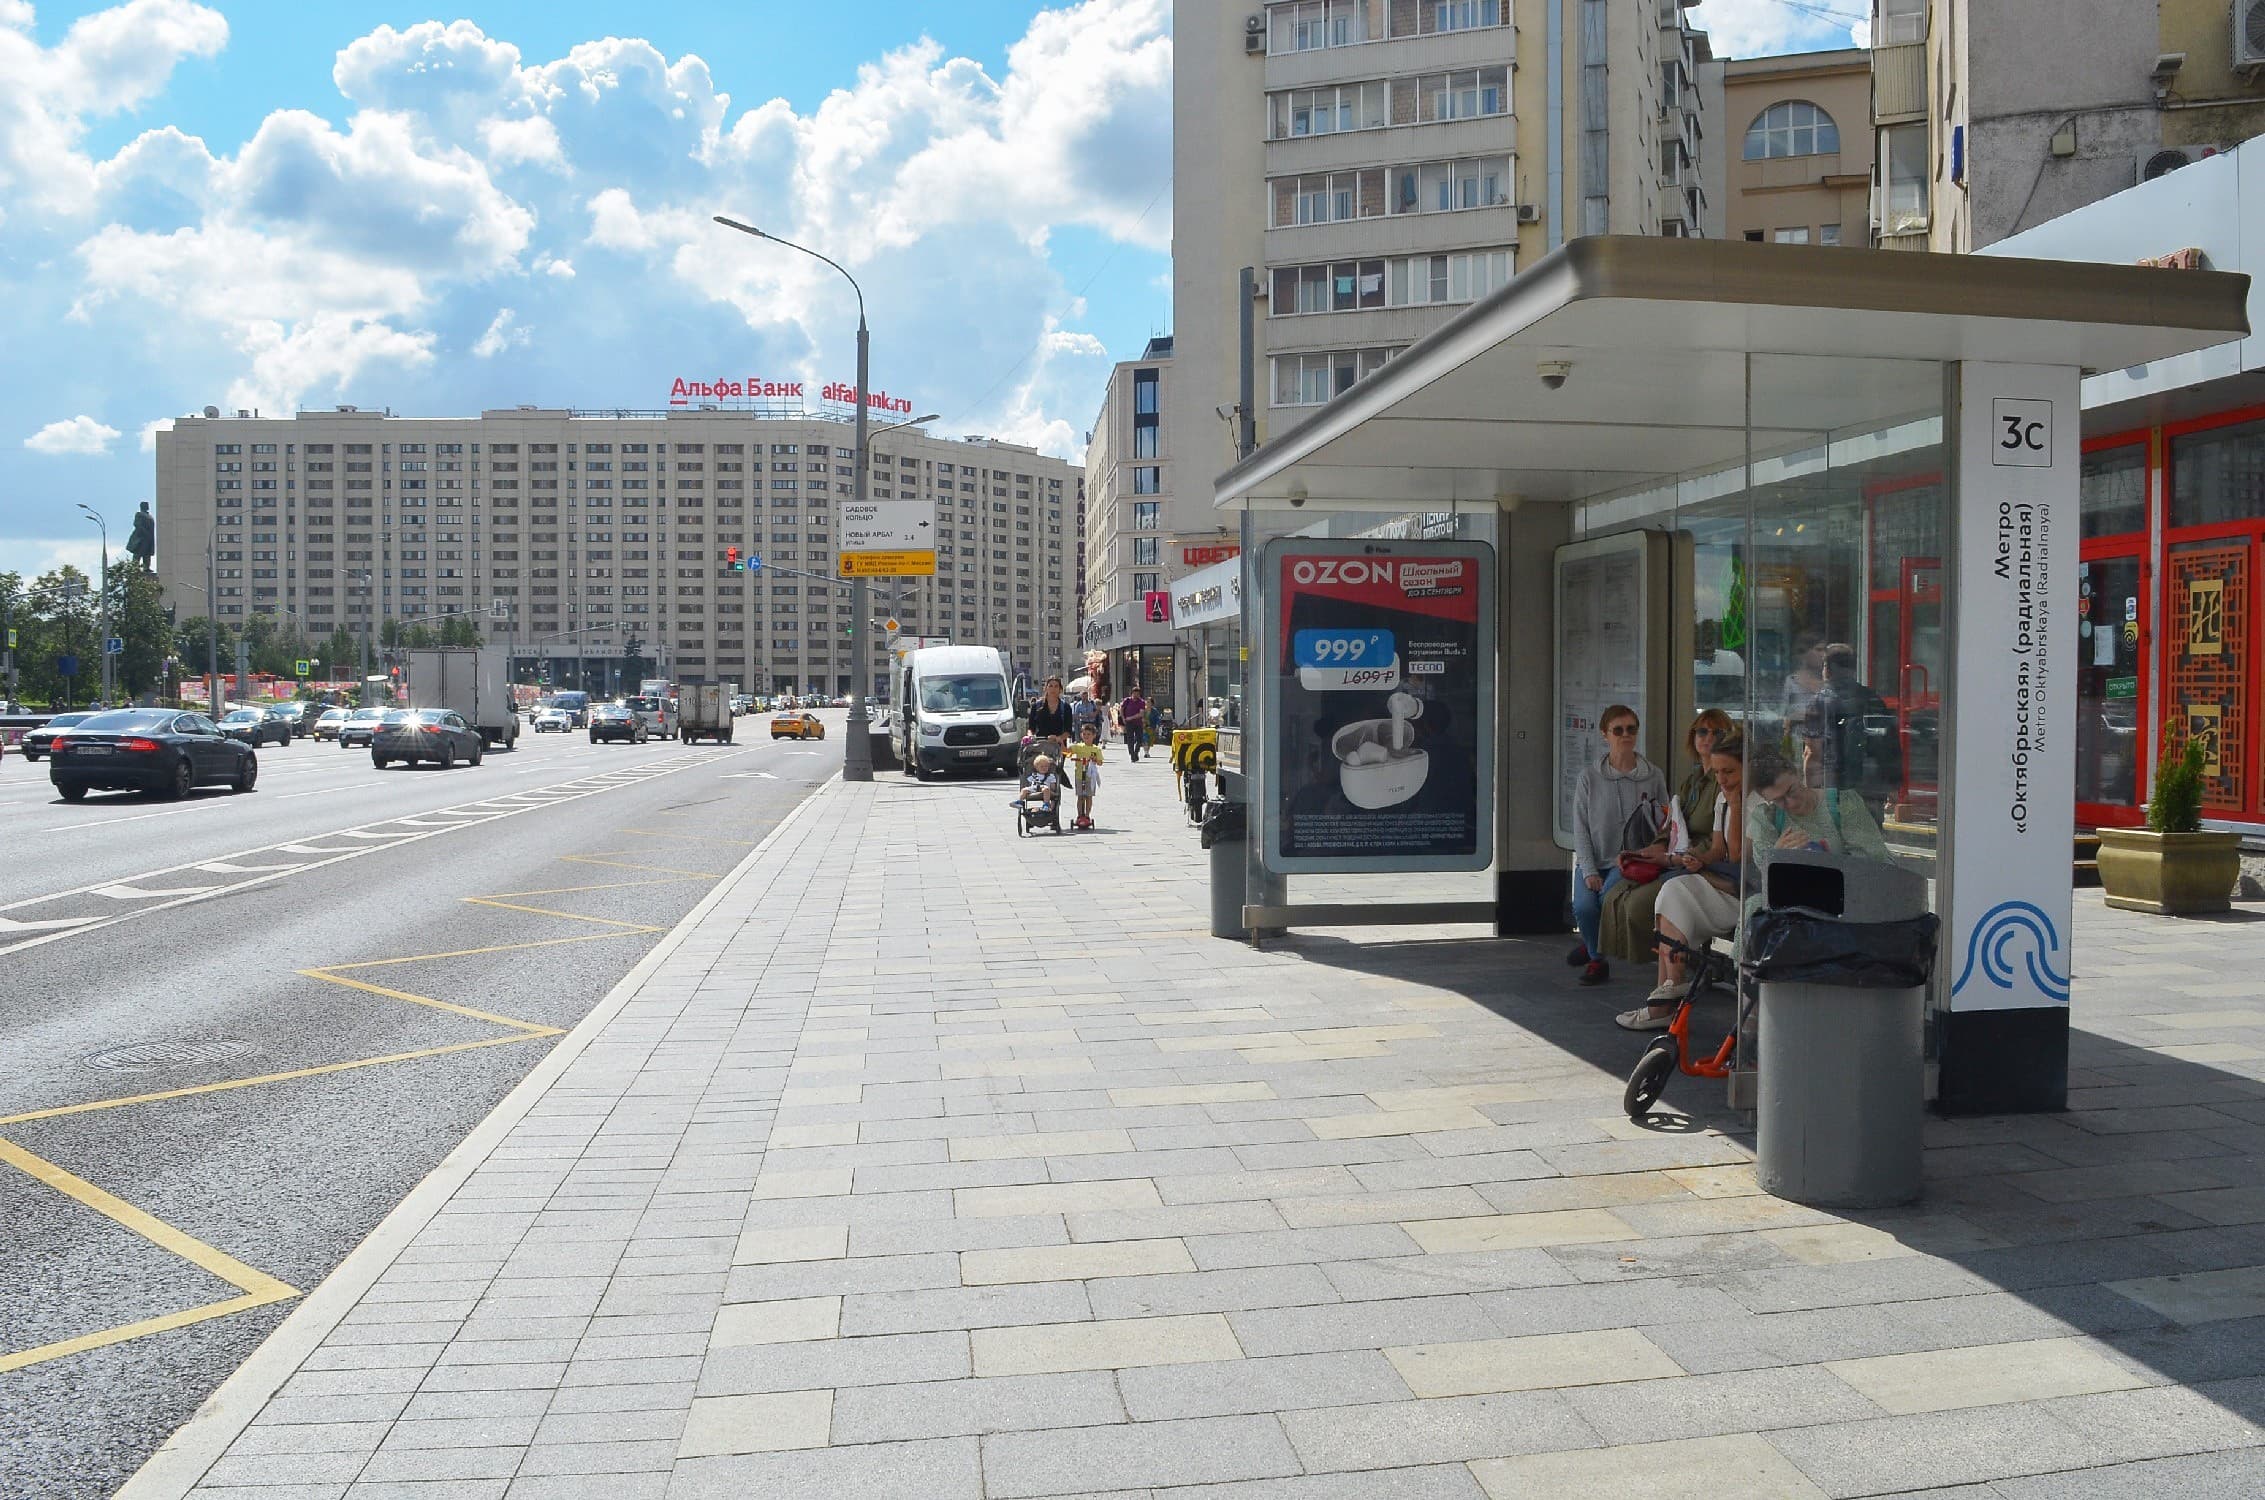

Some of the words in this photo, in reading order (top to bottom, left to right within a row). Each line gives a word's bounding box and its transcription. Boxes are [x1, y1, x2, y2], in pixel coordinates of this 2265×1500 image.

[670, 377, 743, 403] Альфа
[747, 378, 803, 397] Банк
[845, 530, 871, 538] НОВЫЙ
[872, 530, 893, 538] АРБАТ
[1994, 501, 2014, 579] Метро
[1183, 545, 1241, 567] ЦВЕТ
[2036, 503, 2051, 596] (Radialnaya)
[1293, 560, 1393, 584] OZON
[1402, 562, 1459, 577] Школьный
[1403, 577, 1433, 588] сезон
[2012, 503, 2034, 654] (радиальная)
[1314, 639, 1366, 661] 999
[2035, 600, 2050, 702] Oktyabrskaya
[2034, 706, 2046, 753] Metro
[2011, 661, 2032, 834] «Октябрьская»
